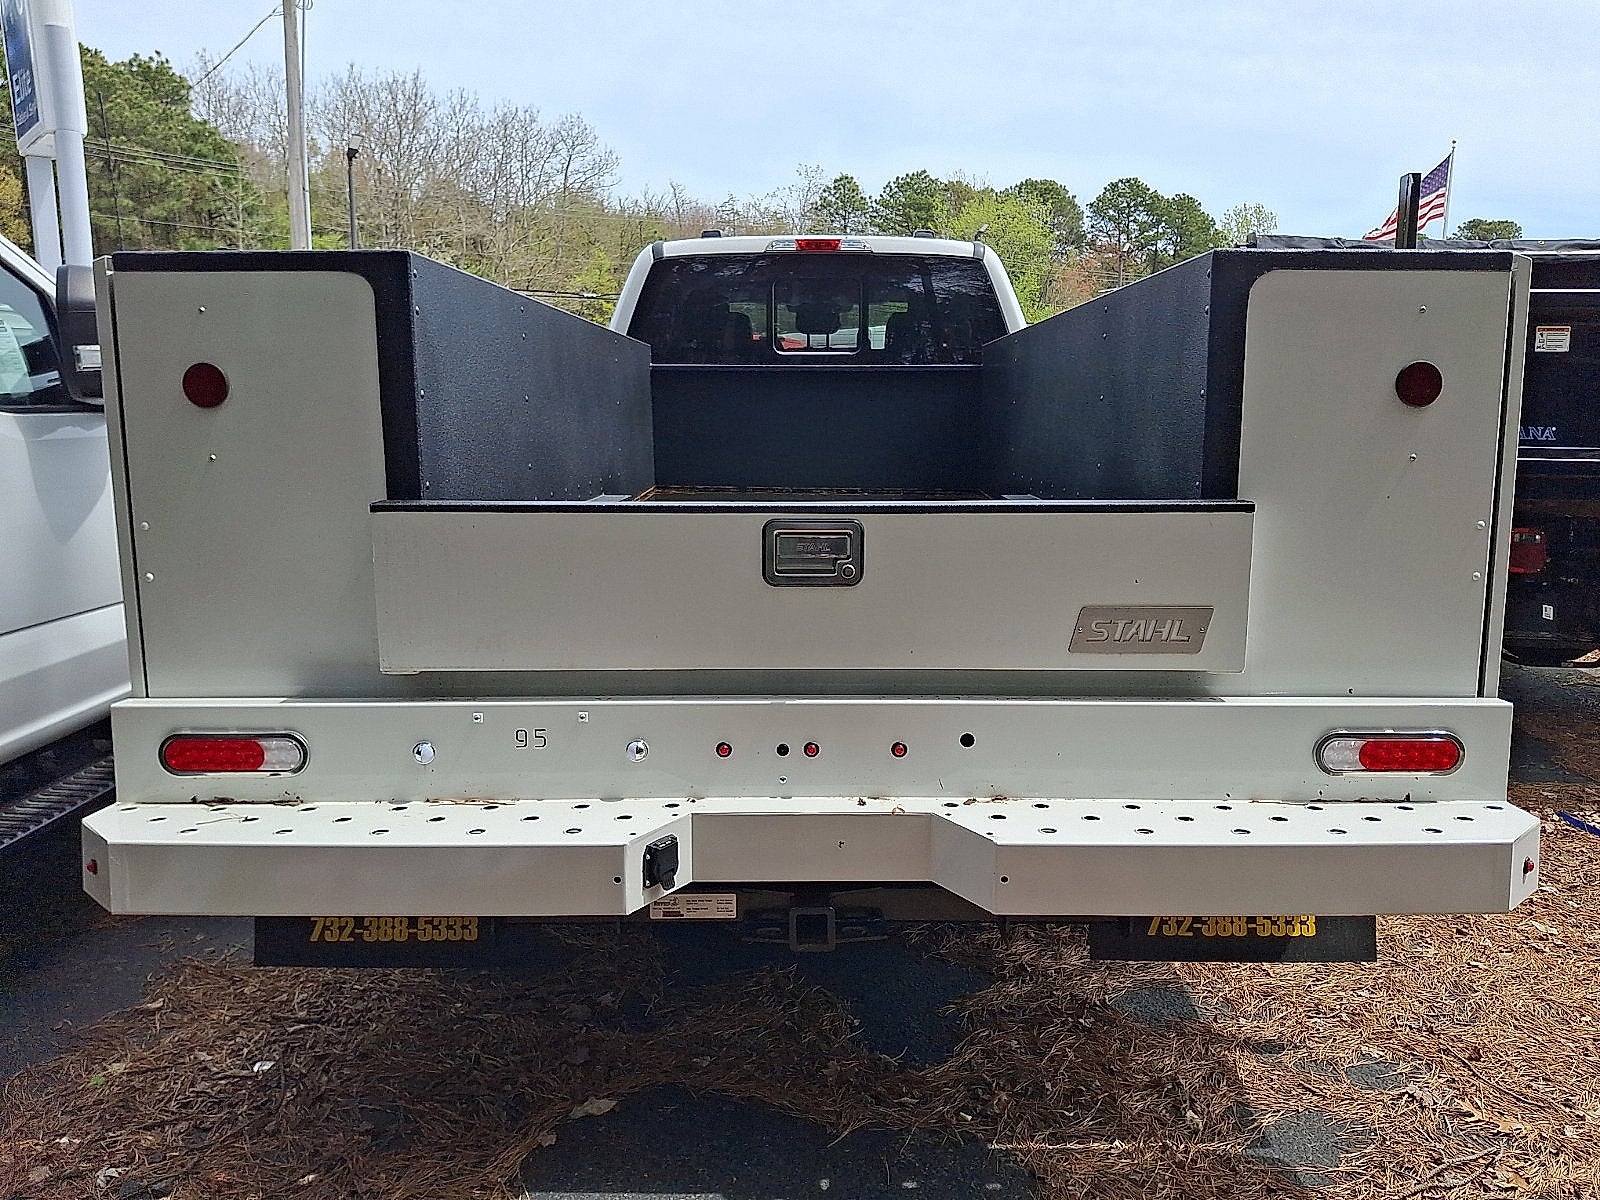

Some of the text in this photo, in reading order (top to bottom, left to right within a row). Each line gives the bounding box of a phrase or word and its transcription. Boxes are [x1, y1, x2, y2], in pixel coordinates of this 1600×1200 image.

[797, 542, 831, 552] STAHL
[1086, 619, 1191, 642] STAHL
[515, 728, 547, 748] 95
[310, 917, 478, 941] 732-388-5333
[1147, 916, 1316, 936] 732-388-5333
